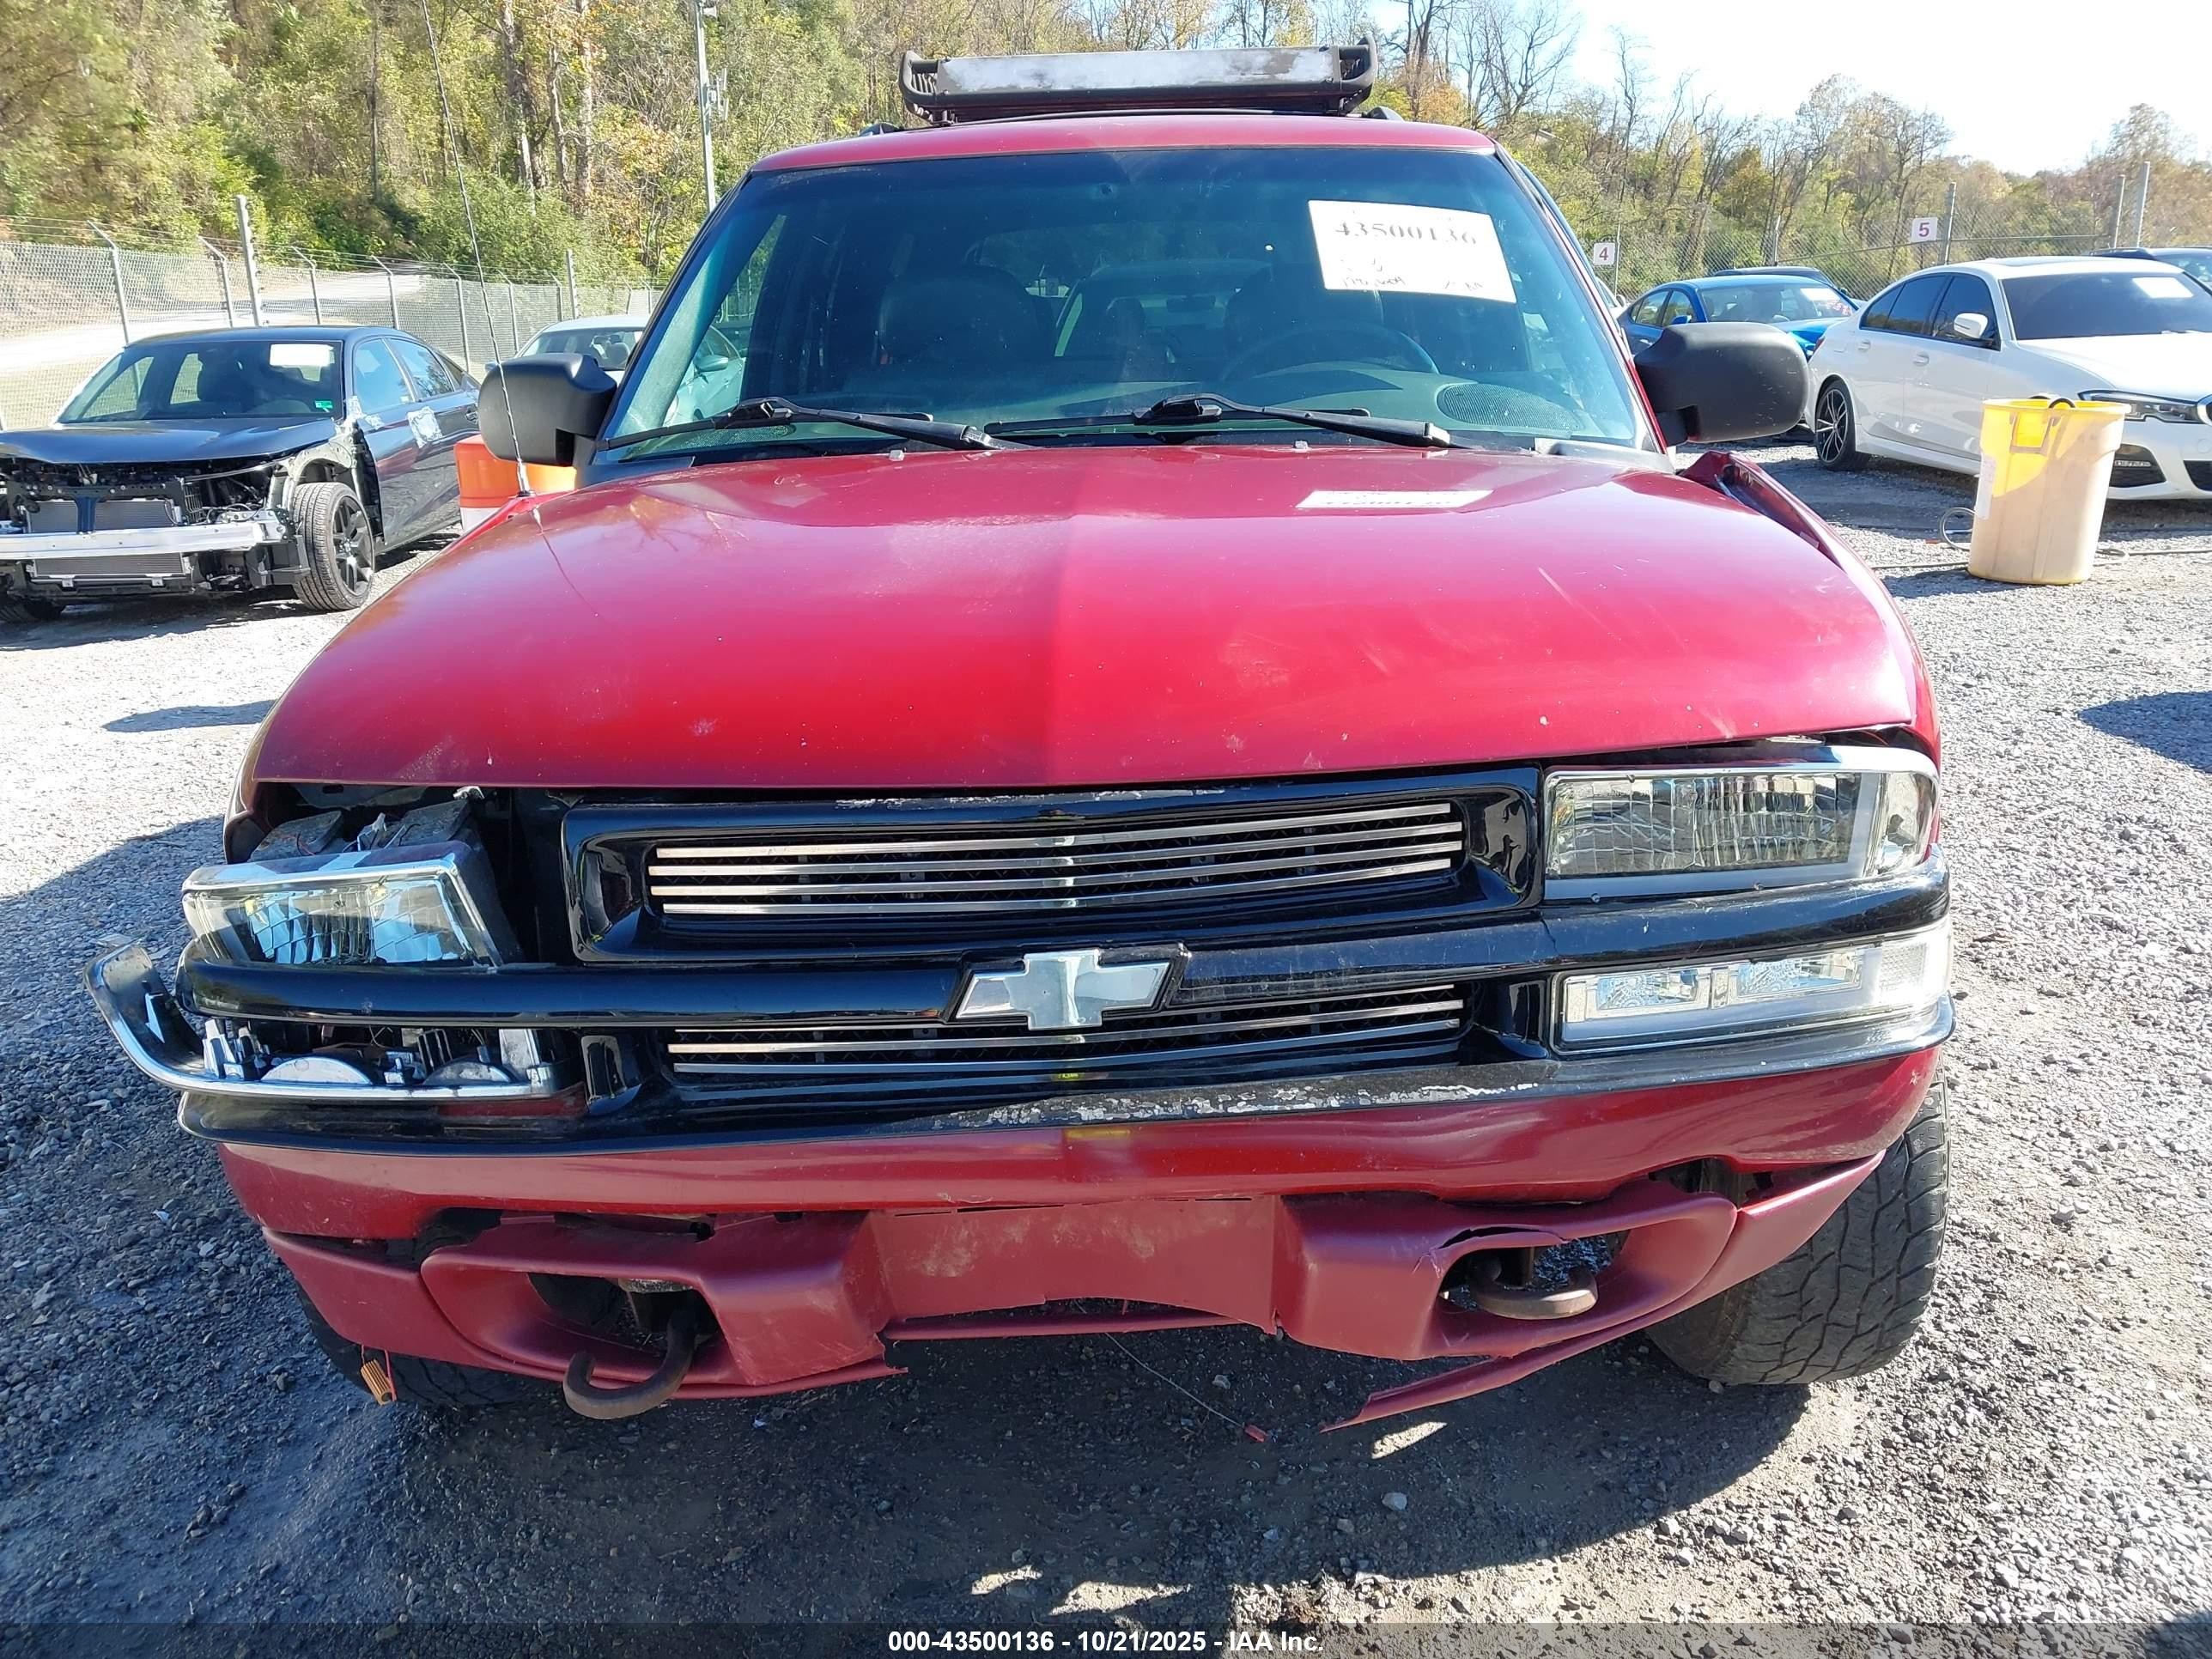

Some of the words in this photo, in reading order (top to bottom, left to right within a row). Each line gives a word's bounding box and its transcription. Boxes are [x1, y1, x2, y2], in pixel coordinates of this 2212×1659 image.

[1335, 221, 1477, 245] 43500136
[1918, 222, 1930, 238] 5
[1599, 246, 1609, 261] 4
